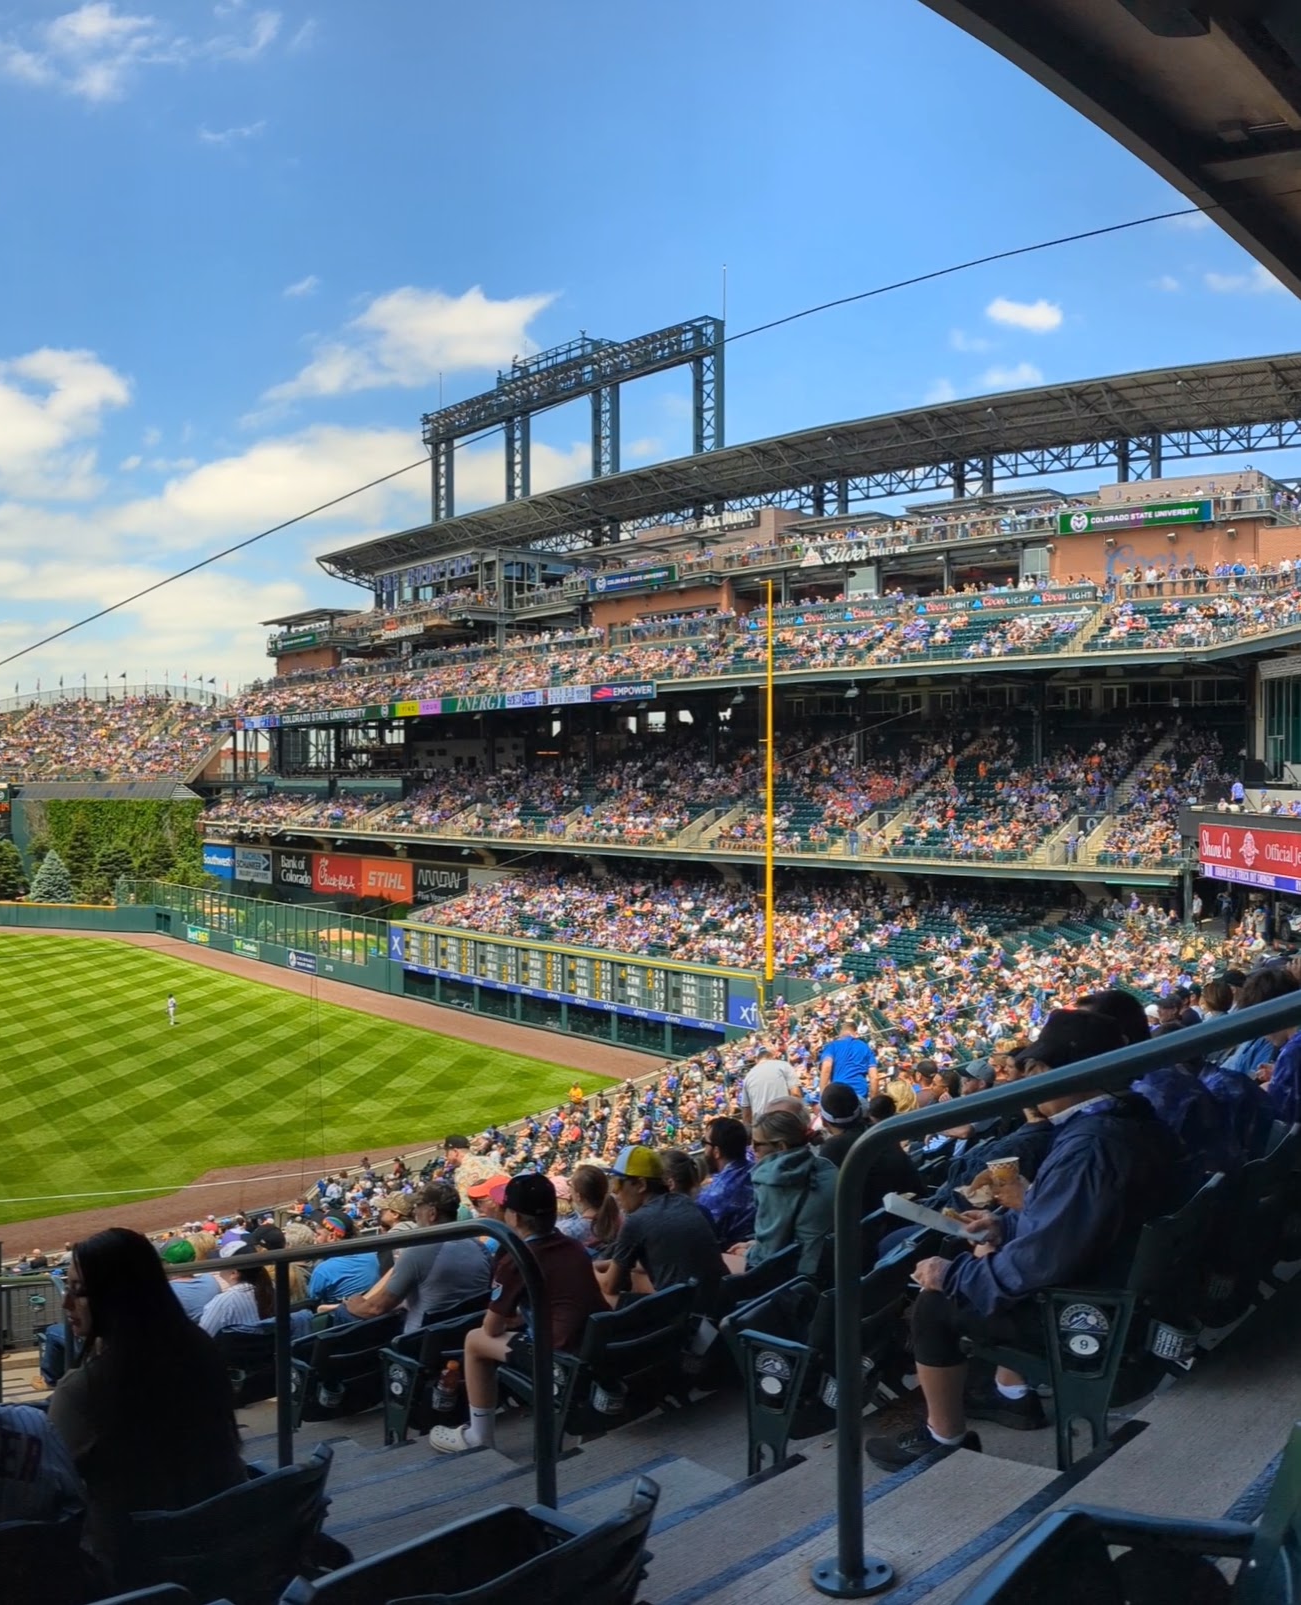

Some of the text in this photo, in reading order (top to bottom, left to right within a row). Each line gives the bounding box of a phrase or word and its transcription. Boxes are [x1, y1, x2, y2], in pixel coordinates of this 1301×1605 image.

[1090, 507, 1200, 525] COLORADO STATE UNIVERSITY
[824, 545, 868, 564] Silver
[376, 555, 472, 595] THE ROOFTOP
[607, 571, 669, 586] COLORADO STATE UNIVERSITY
[1006, 596, 1030, 605] LIGHT
[1067, 591, 1094, 600] LIGHT
[948, 600, 971, 609] LIGHT
[822, 612, 842, 621] LIGHT
[874, 608, 894, 617] LIGHT
[774, 617, 794, 626] LIGHT
[612, 685, 652, 697] EMPOWER
[456, 693, 505, 712] ENERGY
[282, 707, 367, 724] COLORADO STATE UNIVERSITY
[1202, 830, 1222, 858] Shane
[203, 853, 235, 868] Southwest
[1265, 843, 1293, 864] Official
[236, 859, 262, 871] SCHANKER
[281, 854, 306, 870] Bank of
[280, 868, 312, 886] Colorado
[367, 871, 406, 890] STIHL
[417, 868, 461, 889] ARROW
[417, 891, 447, 902] Five Years
[187, 929, 209, 944] bet365
[654, 969, 665, 979] 24
[682, 973, 724, 990] SEA 68
[647, 979, 653, 989] 2
[654, 980, 665, 990] 61
[682, 984, 724, 1000] LAA 31
[655, 990, 665, 1001] 19
[654, 1002, 665, 1012] 57
[682, 996, 724, 1012] BOS 73
[713, 1012, 724, 1023] 55
[1080, 1339, 1089, 1351] 9
